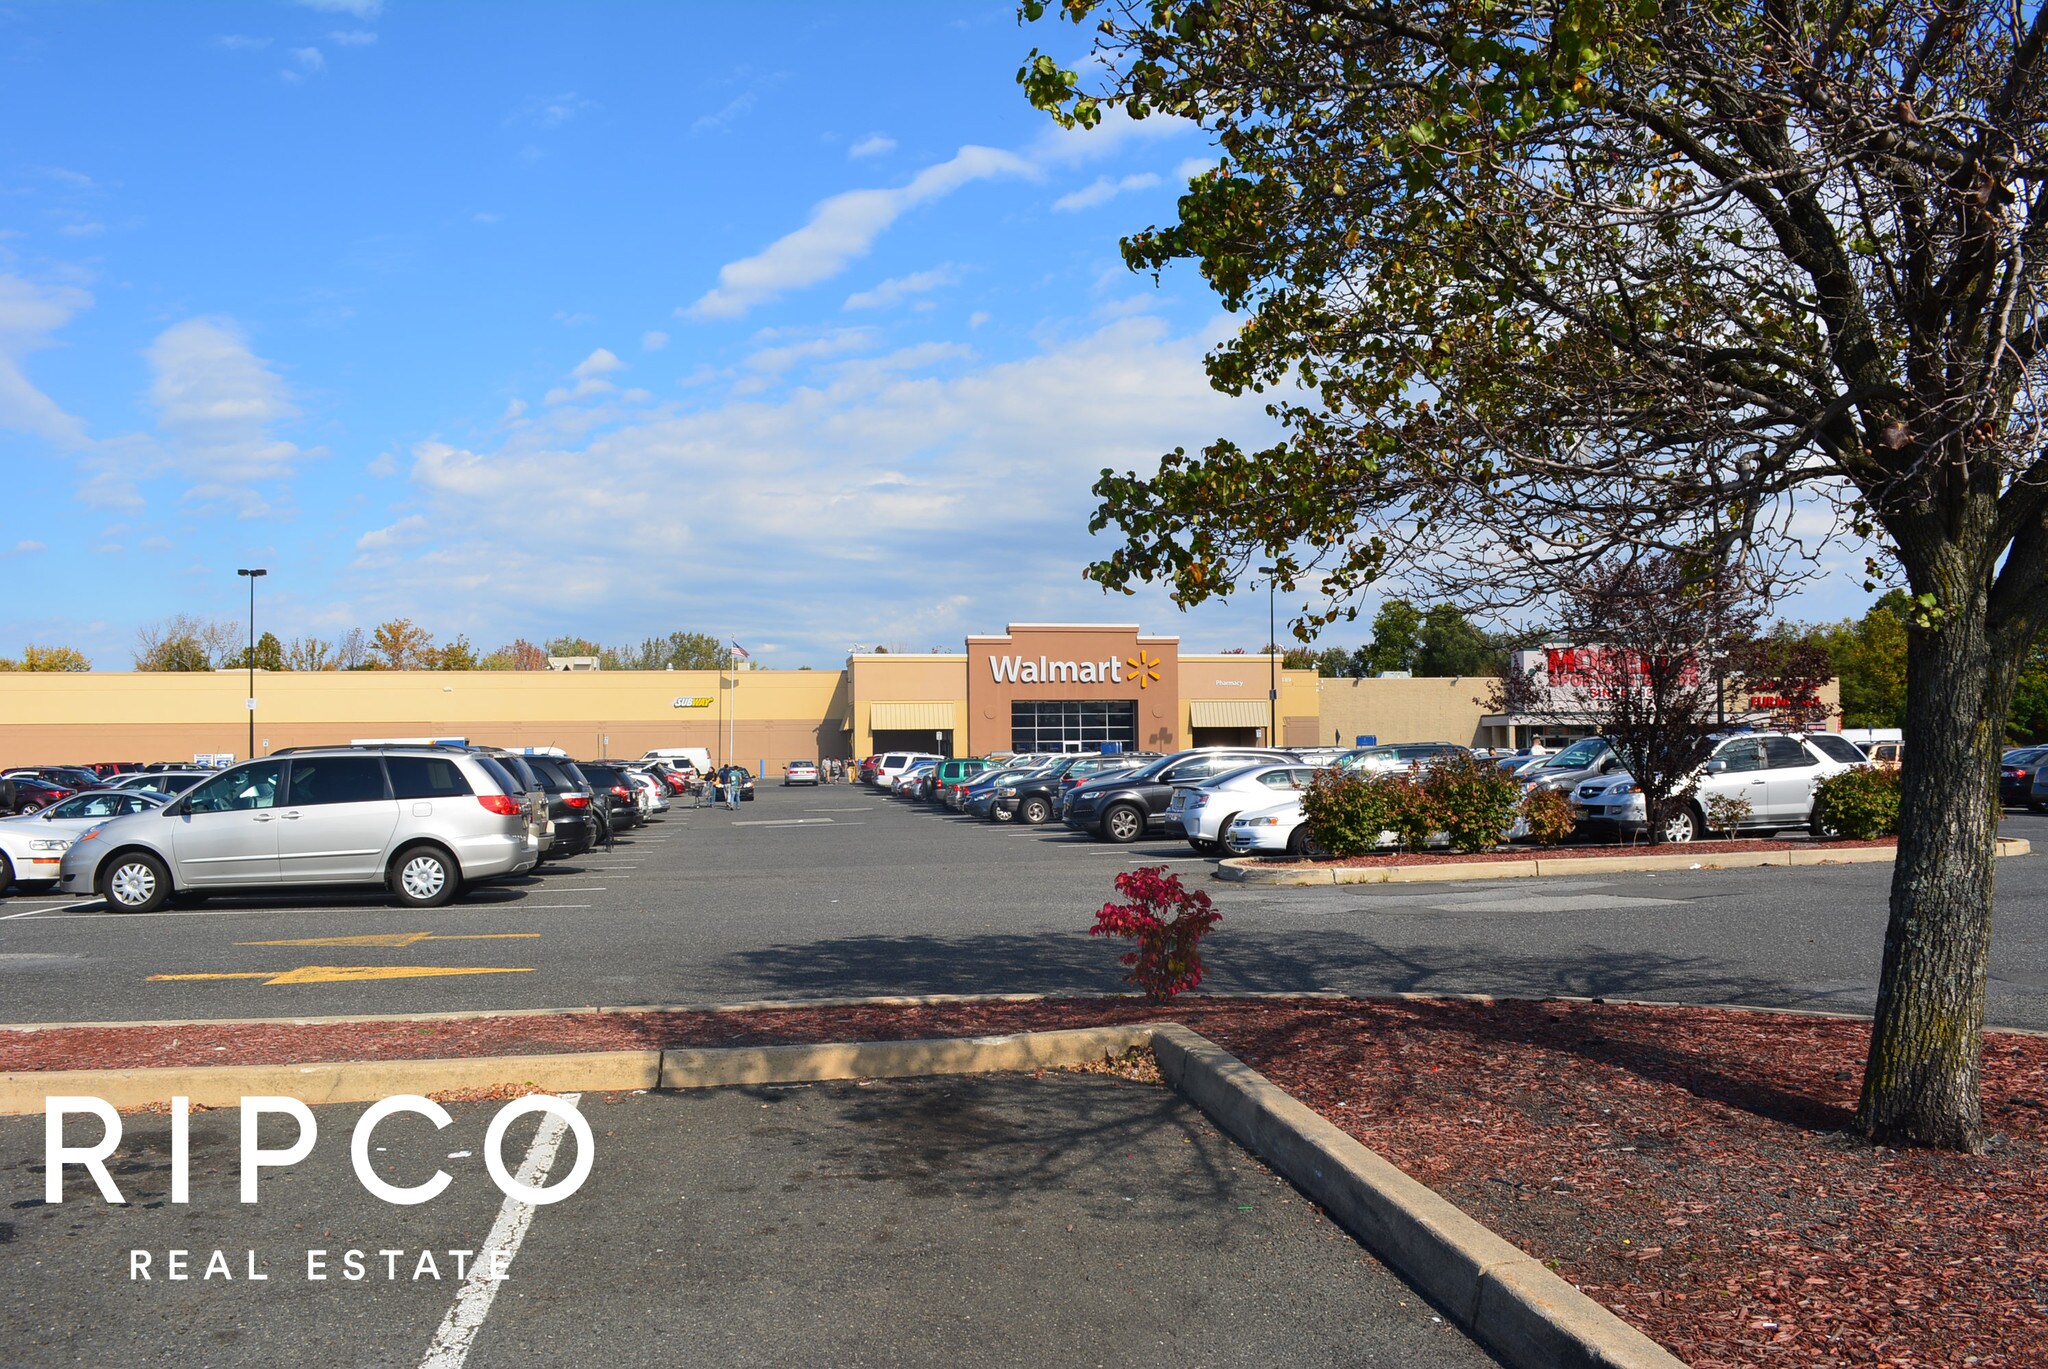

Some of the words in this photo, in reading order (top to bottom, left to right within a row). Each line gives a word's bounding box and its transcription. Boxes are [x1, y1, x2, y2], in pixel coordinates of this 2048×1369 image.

[989, 655, 1122, 683] Walmart
[1215, 679, 1243, 687] Pharmacy
[673, 697, 714, 708] SUBWAY
